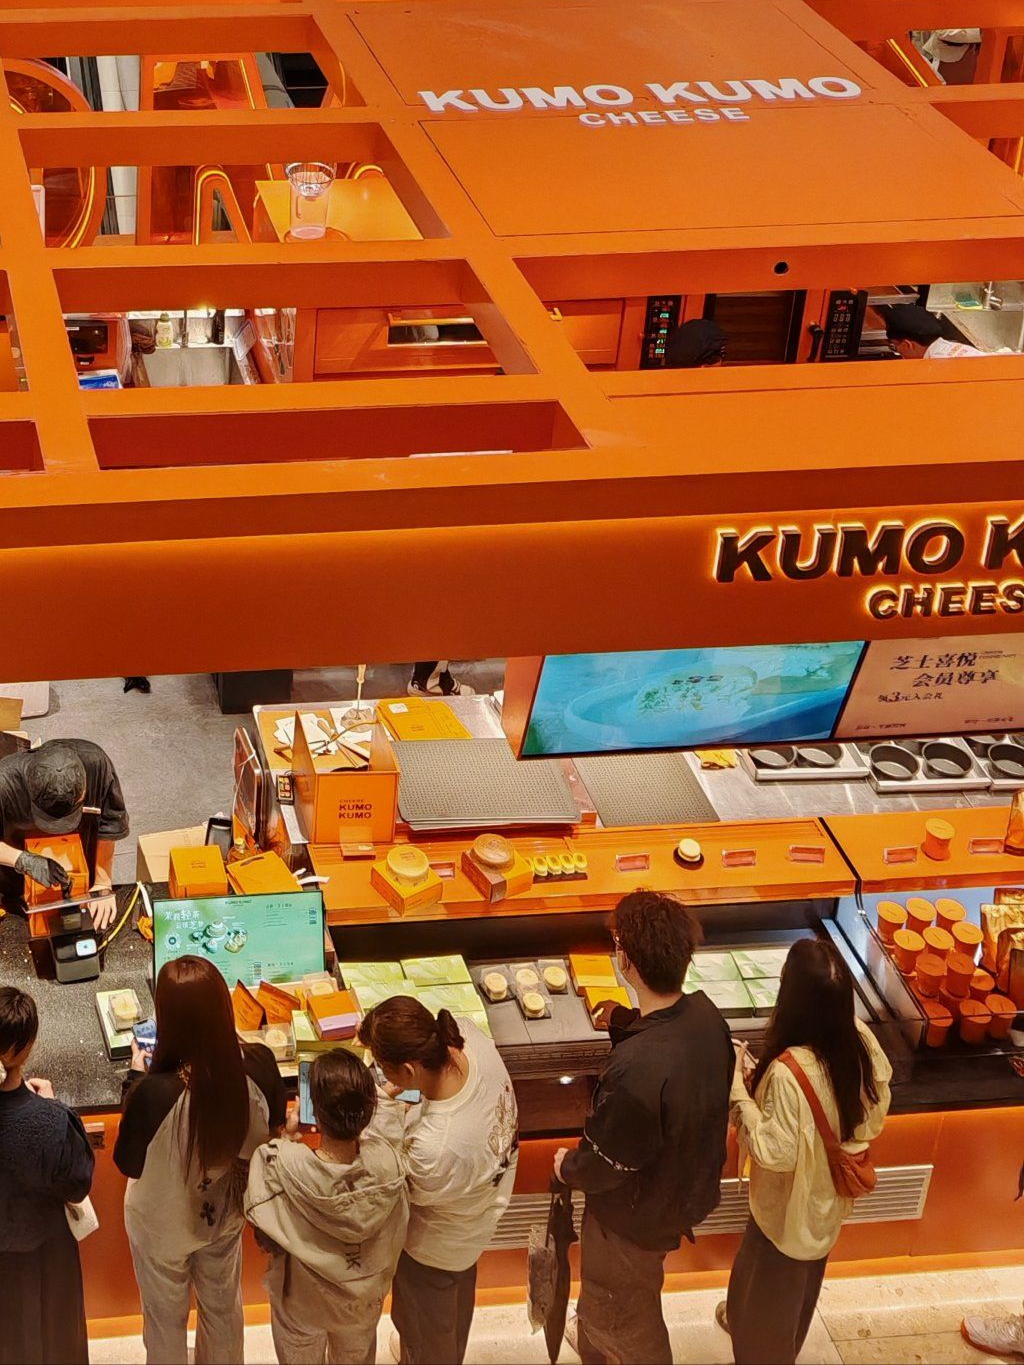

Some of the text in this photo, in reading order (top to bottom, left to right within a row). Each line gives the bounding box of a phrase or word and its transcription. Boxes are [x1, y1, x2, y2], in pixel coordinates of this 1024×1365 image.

[418, 76, 862, 114] KUMO KUMO
[578, 107, 751, 127] CHEESE
[714, 520, 965, 583] KUMO
[890, 651, 978, 670] 芝士喜悦
[913, 669, 1000, 688] 会员尊享
[339, 803, 372, 811] KUMO
